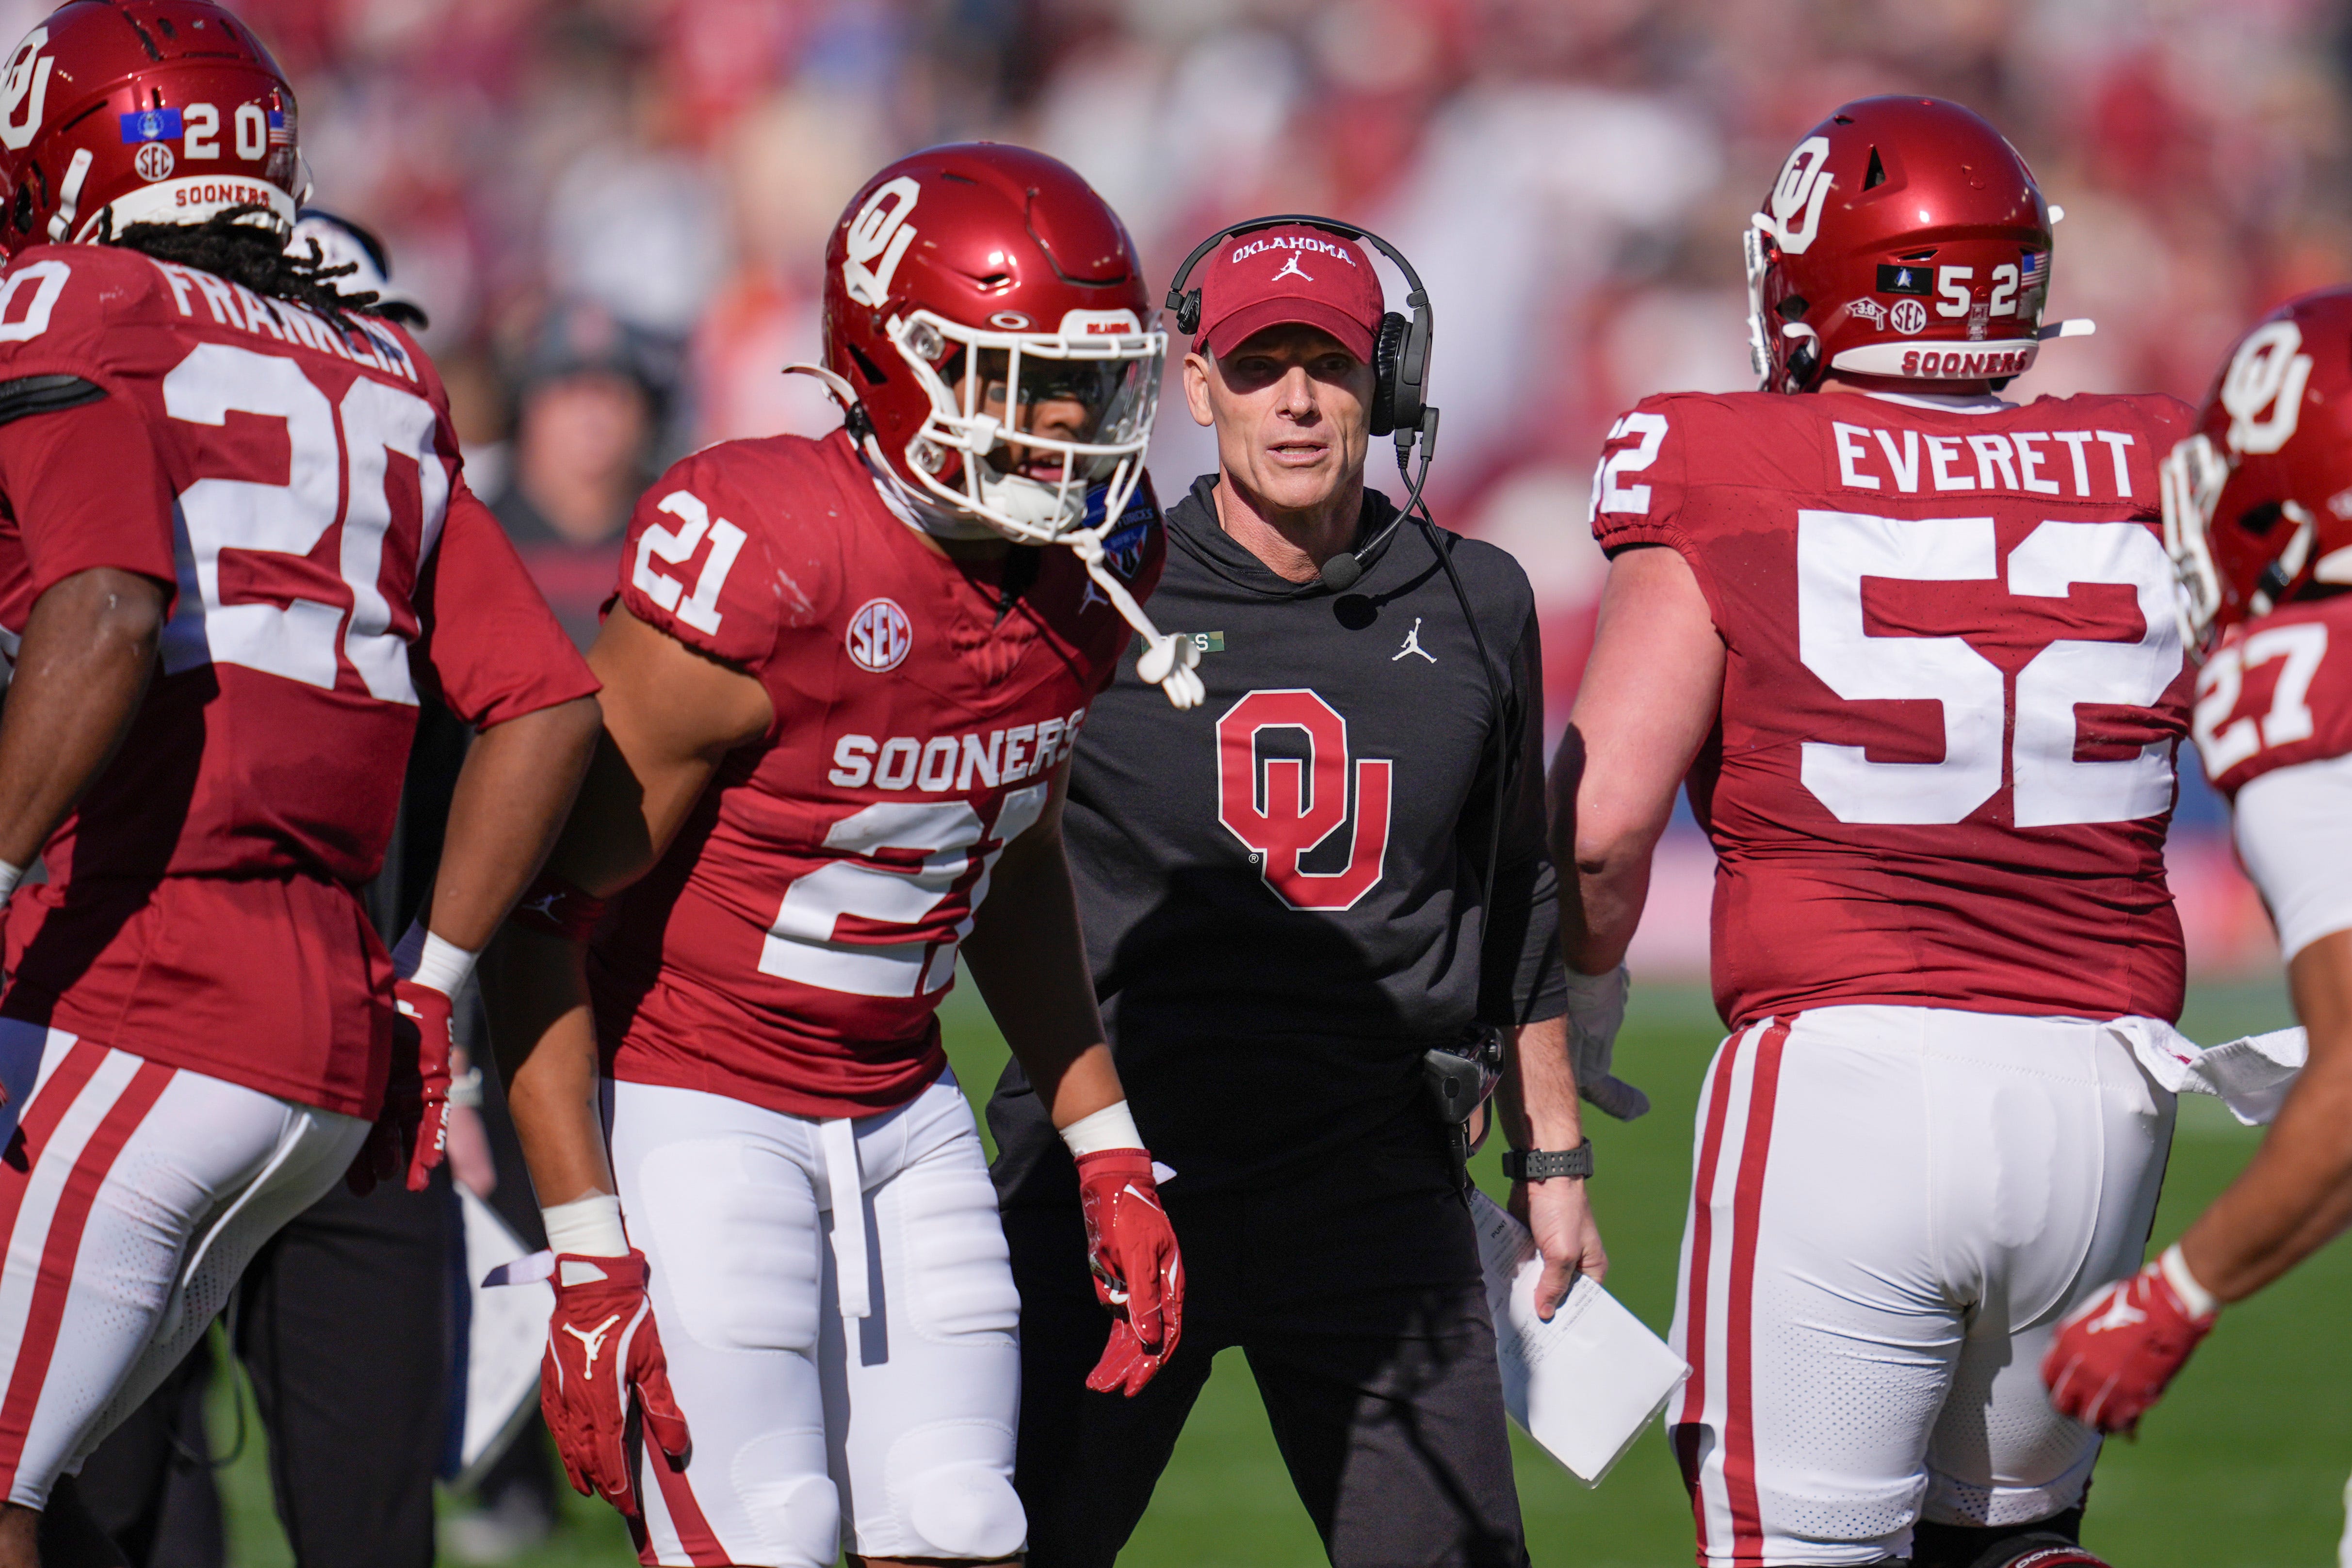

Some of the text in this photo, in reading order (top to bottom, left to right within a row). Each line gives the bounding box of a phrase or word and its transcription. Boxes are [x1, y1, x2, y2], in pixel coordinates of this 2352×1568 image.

[139, 145, 170, 178] SEC
[184, 103, 266, 160] 20
[176, 185, 270, 207] SOONERS
[1772, 136, 1834, 254] OU
[842, 176, 921, 309] OU
[1233, 237, 1353, 264] OKLAHOMA
[0, 260, 71, 343] 0
[1894, 301, 1923, 332] SEC
[1936, 263, 2018, 318] 52
[1901, 351, 2027, 374] SOONERS
[1589, 412, 1669, 523] 2
[1833, 421, 2134, 498] EVERETT
[163, 342, 449, 706] 20
[632, 489, 747, 636] 21
[852, 602, 906, 667] SEC
[1798, 509, 2184, 828] 52
[2193, 622, 2328, 780] 27
[827, 707, 1086, 792] SOONERS
[1217, 688, 1392, 911] OU
[1491, 1219, 1507, 1239] PUNT
